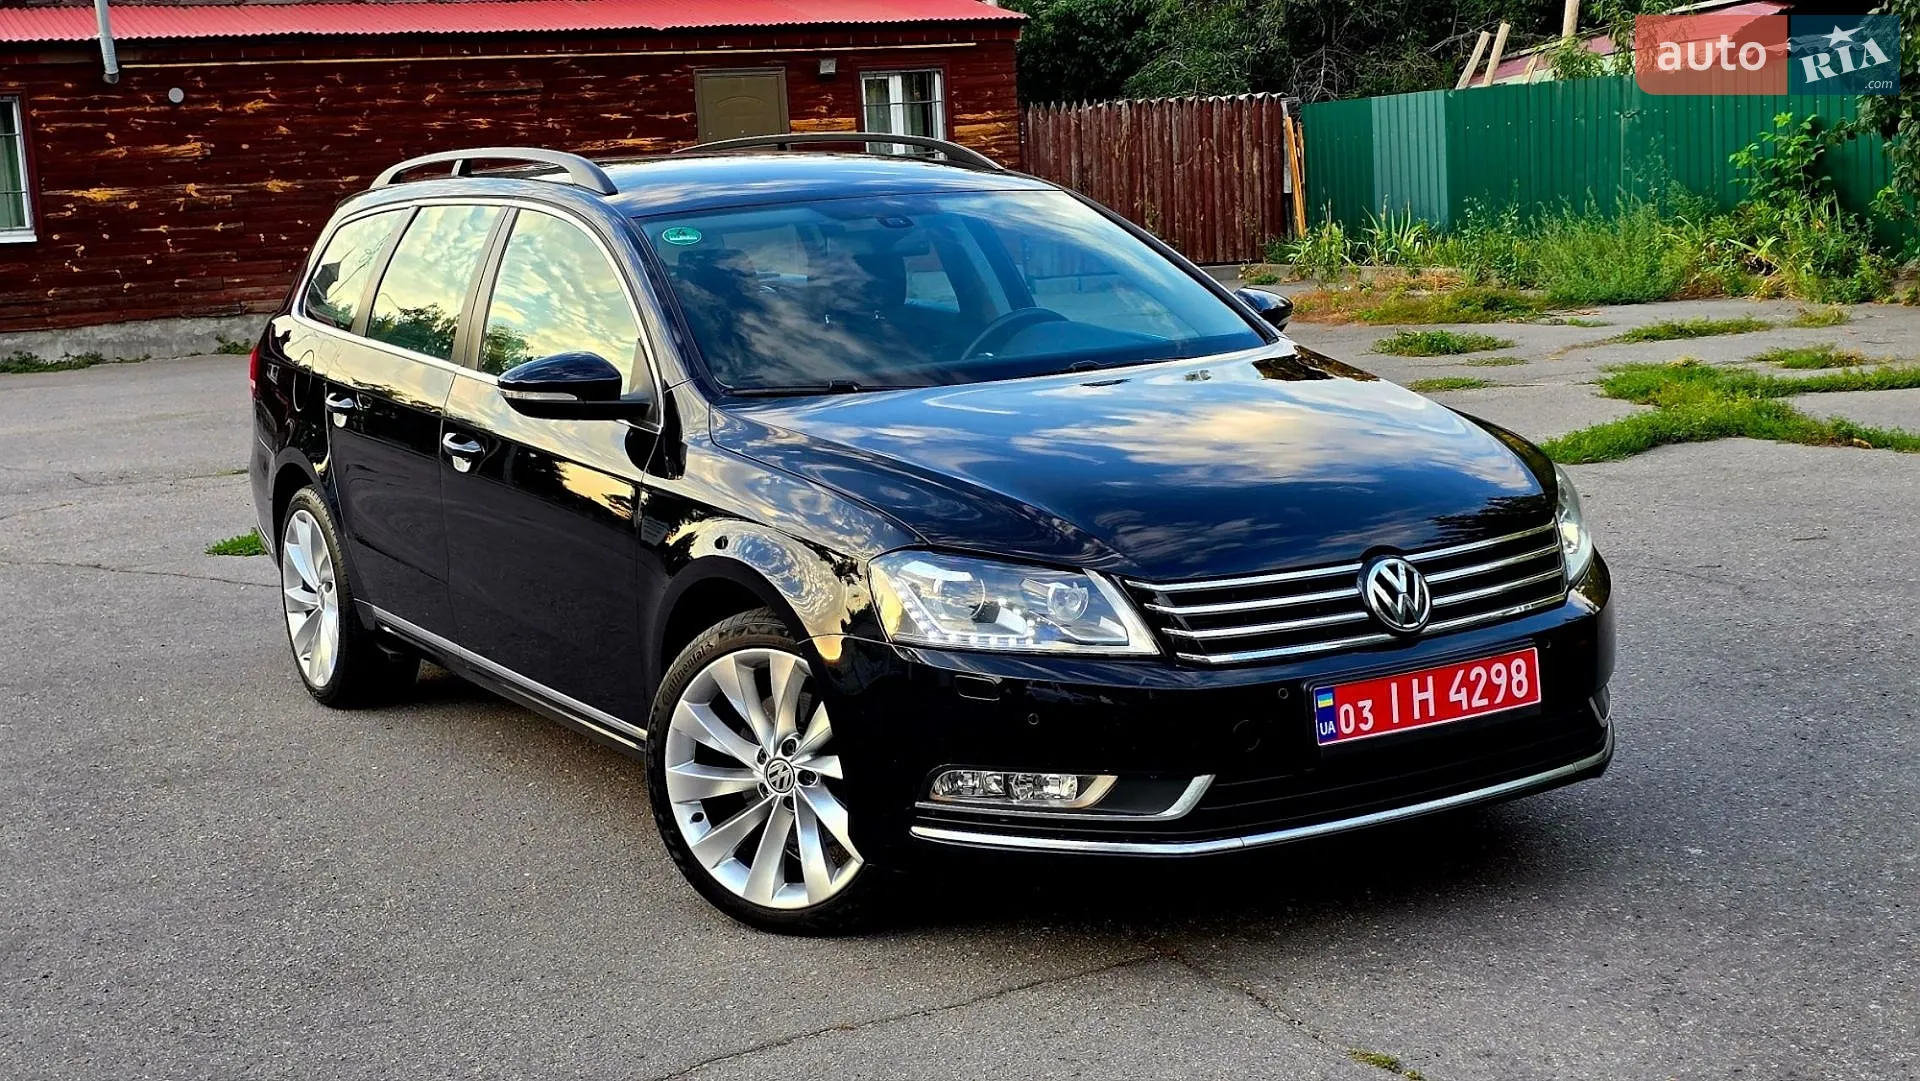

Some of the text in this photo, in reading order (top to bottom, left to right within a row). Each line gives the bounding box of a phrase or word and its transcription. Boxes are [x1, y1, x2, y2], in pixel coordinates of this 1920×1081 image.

[1339, 699, 1374, 735] 03
[1448, 657, 1529, 712] 4298
[1319, 721, 1336, 736] UA
